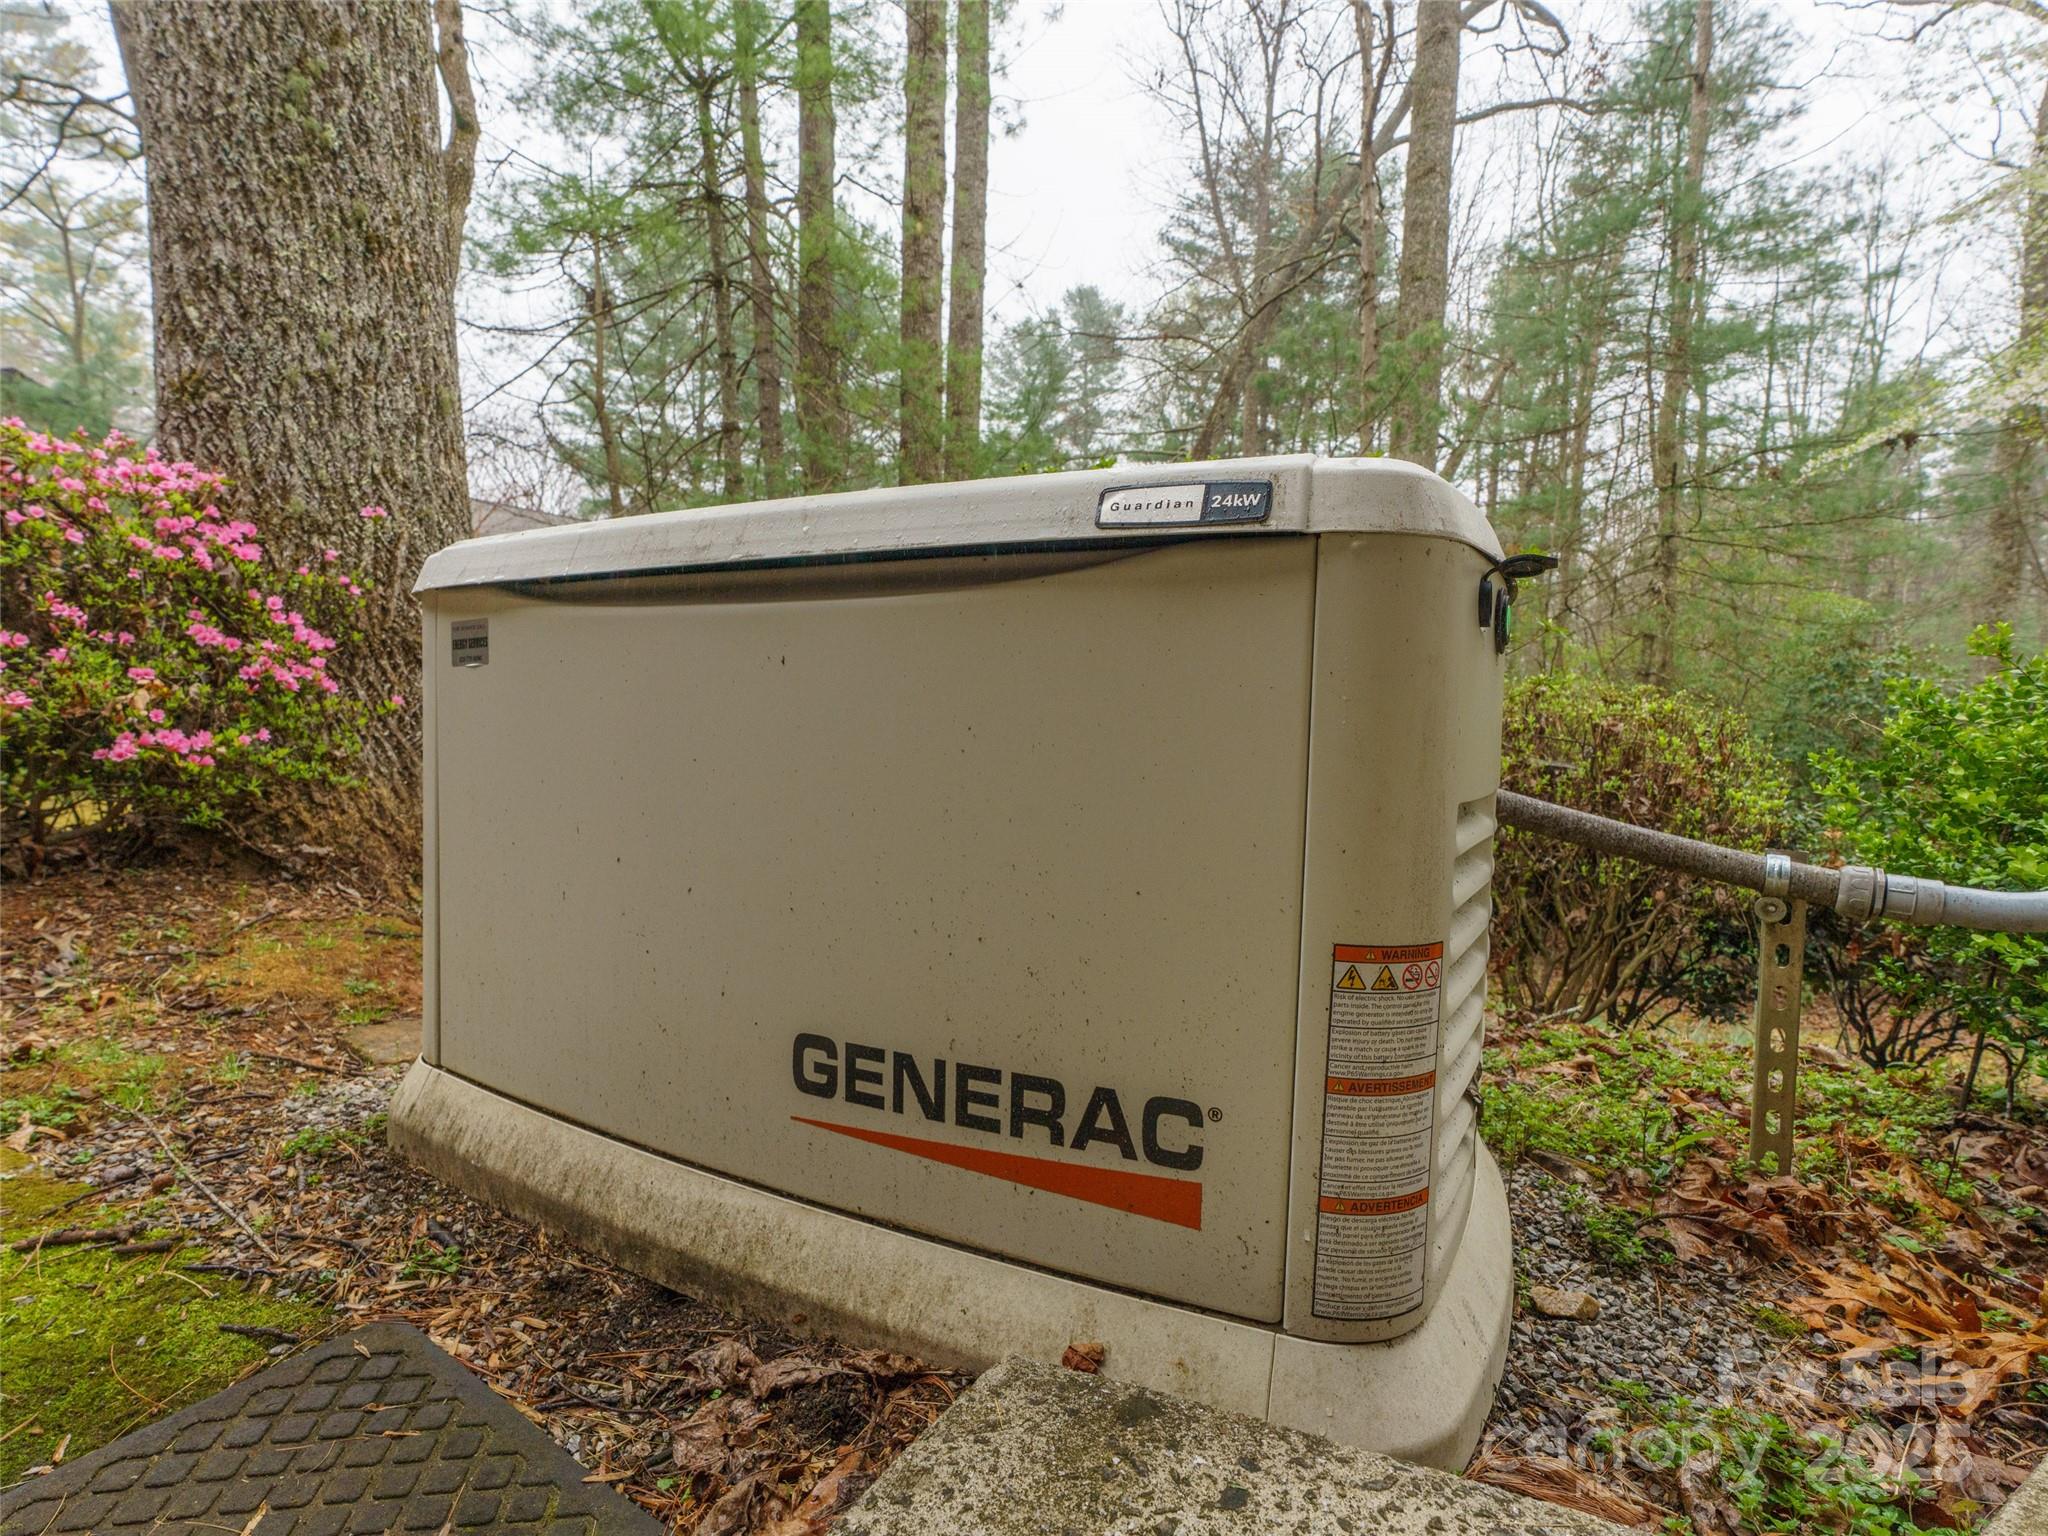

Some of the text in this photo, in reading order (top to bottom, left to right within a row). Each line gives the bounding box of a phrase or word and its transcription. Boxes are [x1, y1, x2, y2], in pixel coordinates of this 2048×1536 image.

[1110, 493, 1262, 512] Guardian 24kW
[1381, 948, 1430, 960] WARNING
[1332, 1028, 1361, 1036] Explosion
[1330, 1062, 1351, 1070] Cancer
[1348, 1073, 1434, 1093] AVERTISSEMENT
[1328, 1095, 1349, 1103] Risque
[1350, 1193, 1423, 1212] ADVERTENCIA
[1315, 1301, 1341, 1309] Produce
